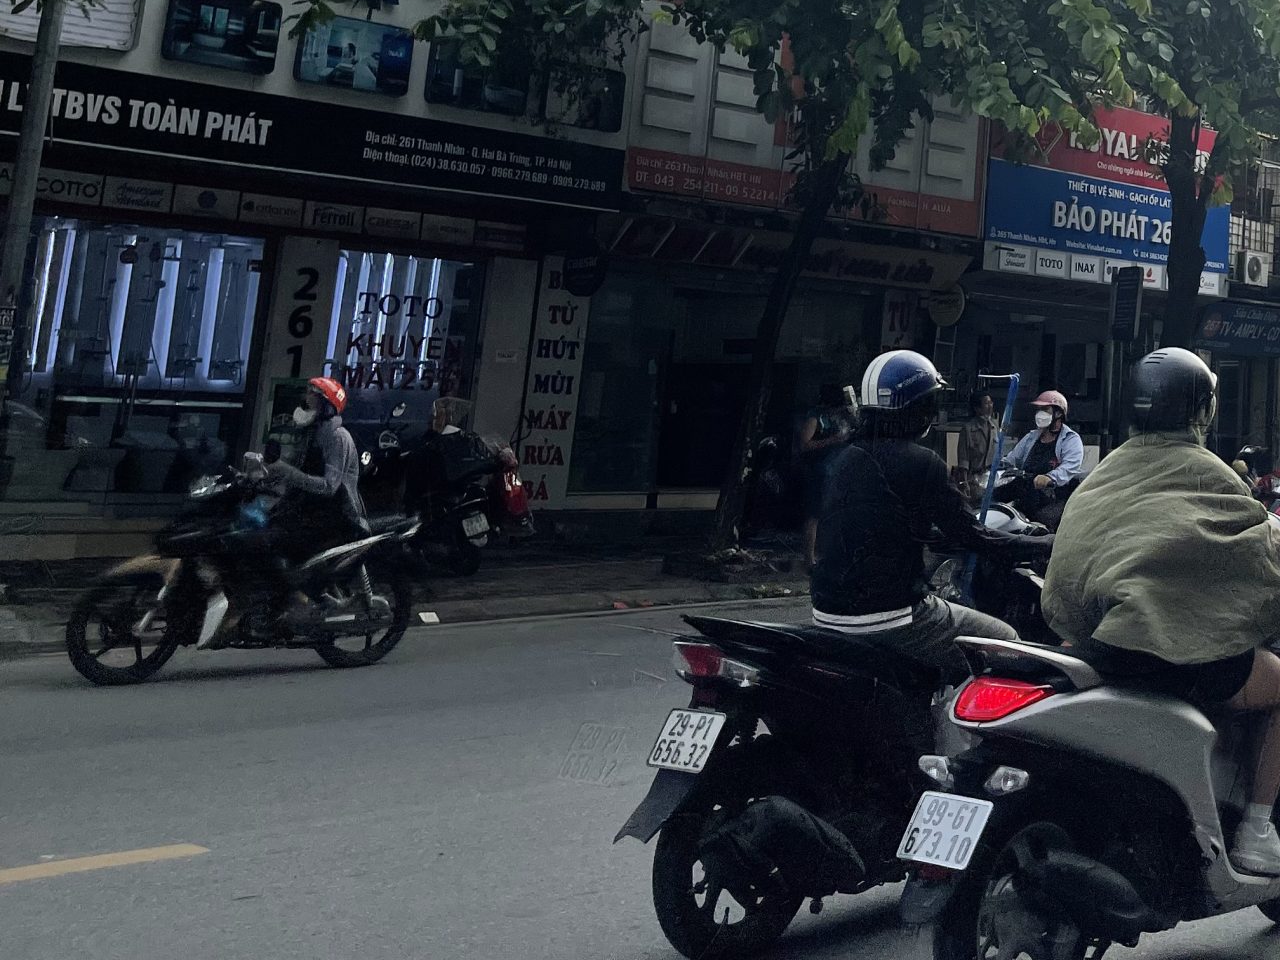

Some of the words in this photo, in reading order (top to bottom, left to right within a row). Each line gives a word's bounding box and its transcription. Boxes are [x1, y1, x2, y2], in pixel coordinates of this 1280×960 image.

[52, 87, 122, 125] TBVS
[128, 98, 201, 136] TOÀN
[203, 111, 273, 147] PHÁT
[363, 146, 383, 161] Điện
[411, 153, 436, 169] (024)
[399, 136, 415, 148] 261
[417, 138, 443, 152] Thanh
[482, 148, 495, 160] Hai
[665, 160, 681, 171] 263
[37, 177, 99, 199] COTTO
[1068, 180, 1089, 193] THIẾT
[1090, 183, 1097, 197] BỊ
[1098, 184, 1108, 197] VỆ
[1108, 187, 1124, 199] SINH
[1129, 192, 1149, 205] GẠCH
[1149, 193, 1159, 205] ỐP
[1053, 195, 1096, 233] BẢO
[1100, 208, 1149, 241] PHÁT
[1039, 257, 1063, 270] TOTO
[1074, 261, 1096, 274] INAX
[359, 292, 443, 319] TOTO
[1234, 322, 1264, 340] AMPLY
[346, 327, 465, 361] KHUYẾN
[536, 335, 579, 360] HÚT
[533, 370, 574, 394] MÙI
[527, 405, 572, 430] MÁY
[522, 437, 565, 466] RỬA
[668, 712, 715, 740] 29-P1
[652, 738, 708, 768] 656.32
[923, 799, 979, 832] 99-G1
[904, 827, 972, 864] 673.10
